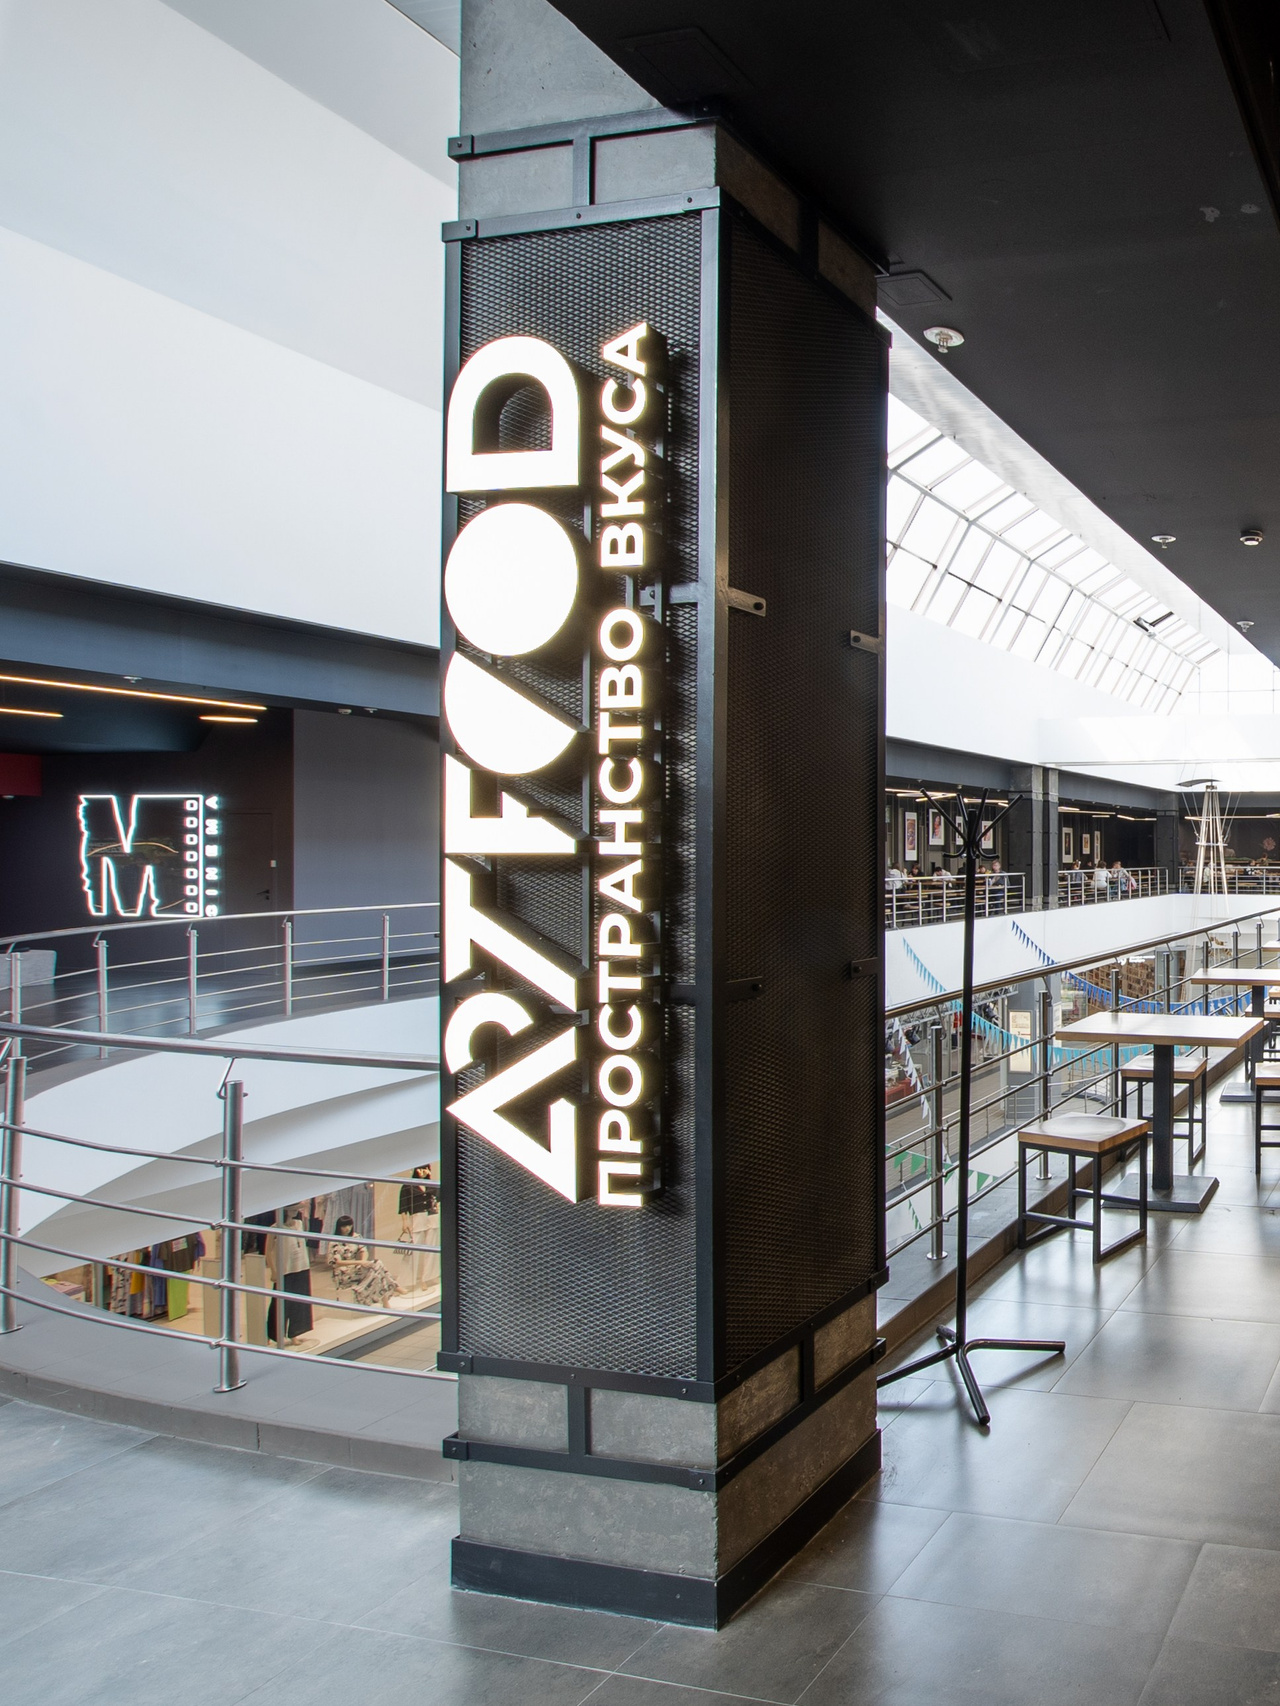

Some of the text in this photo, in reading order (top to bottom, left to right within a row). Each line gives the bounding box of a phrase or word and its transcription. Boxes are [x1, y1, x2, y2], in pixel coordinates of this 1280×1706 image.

[204, 795, 219, 918] CINEMA
[598, 321, 648, 1208] ПРОСТРАНСТВО ВКУСА
